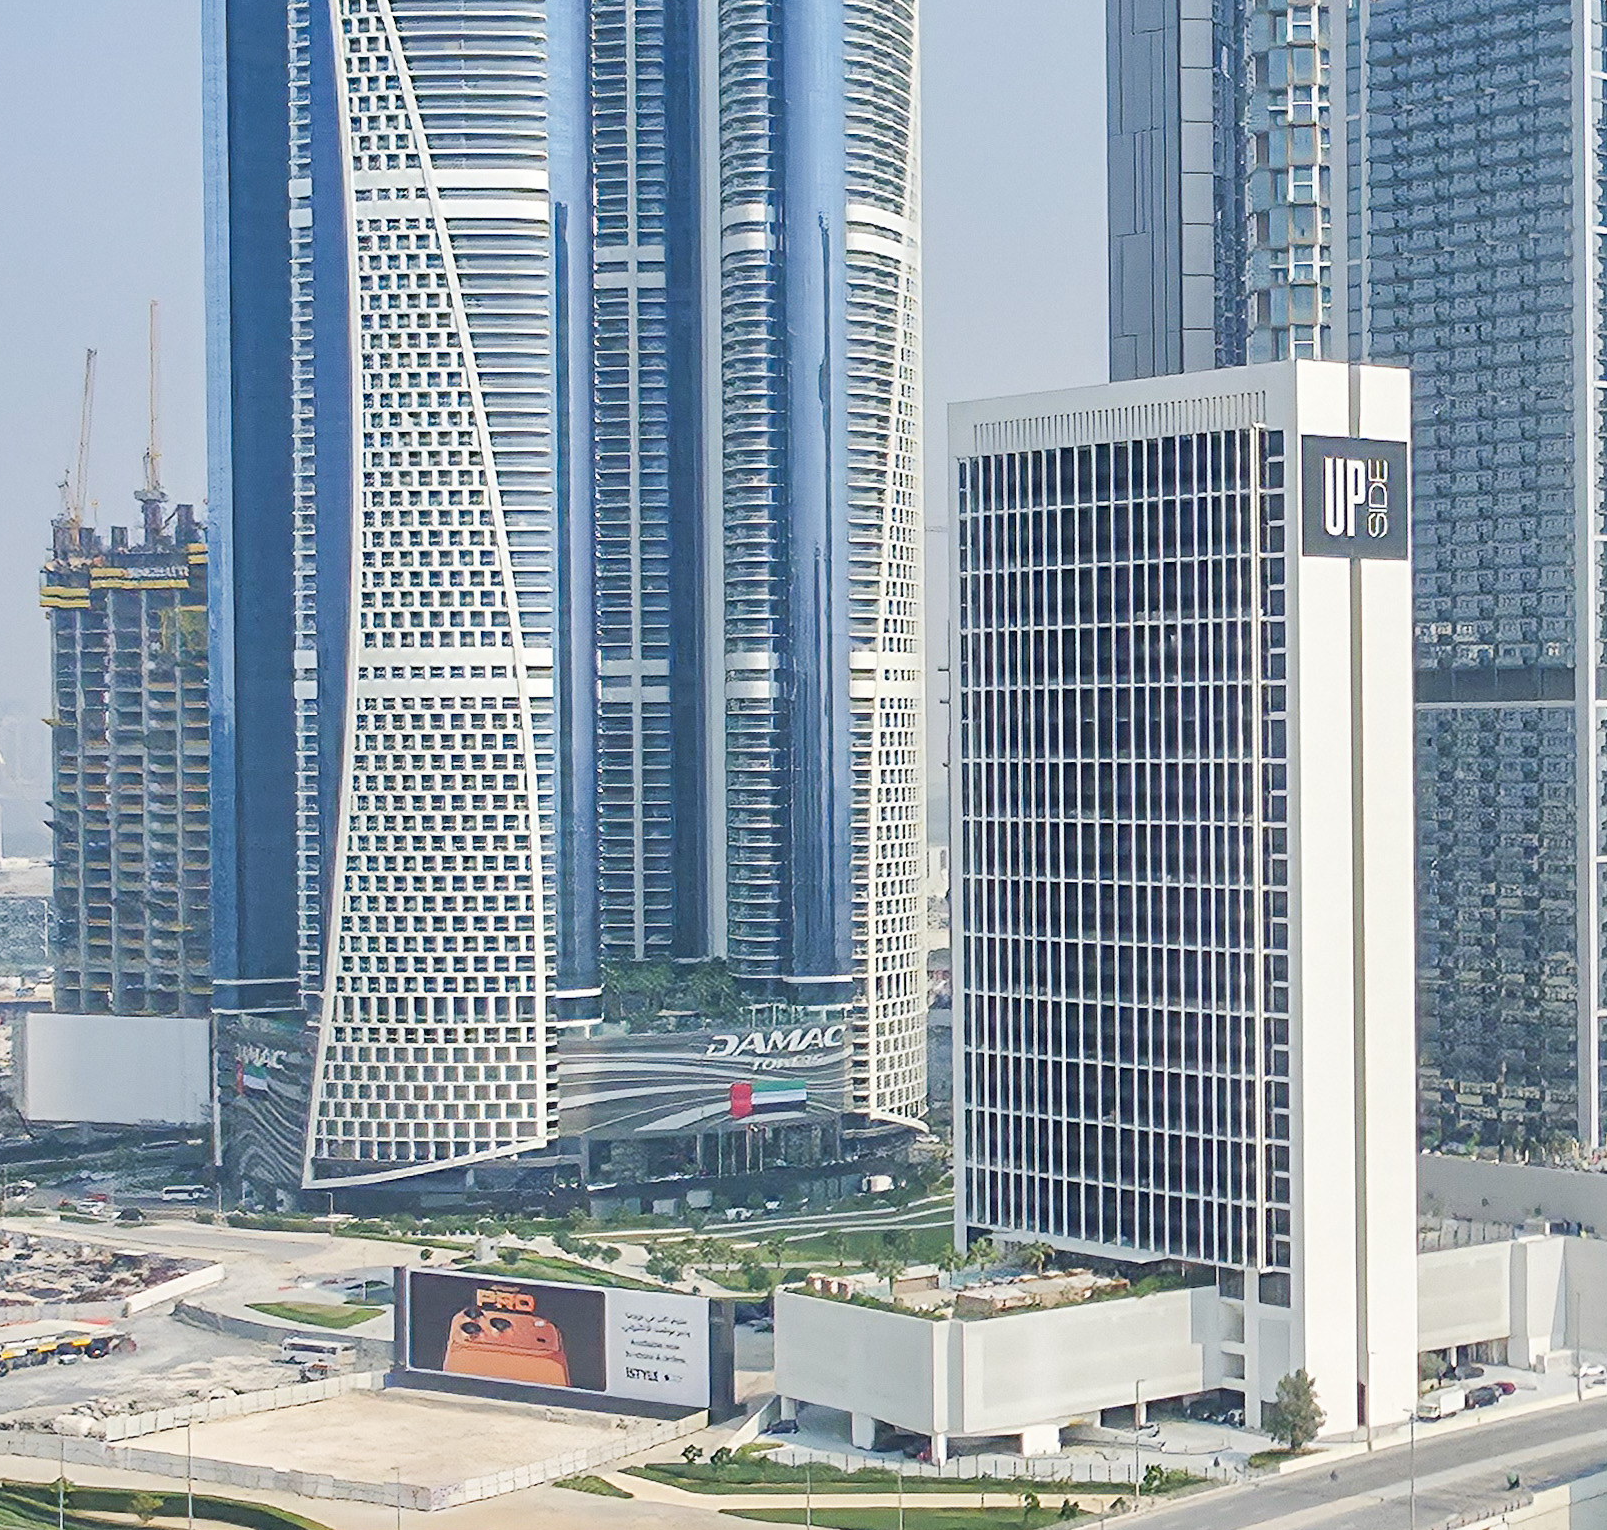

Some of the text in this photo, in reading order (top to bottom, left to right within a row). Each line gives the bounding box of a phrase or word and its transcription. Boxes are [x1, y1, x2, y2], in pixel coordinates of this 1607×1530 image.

[1324, 456, 1389, 538] UP SIDE
[705, 1024, 848, 1057] DAMAC
[476, 1288, 535, 1313] PRO
